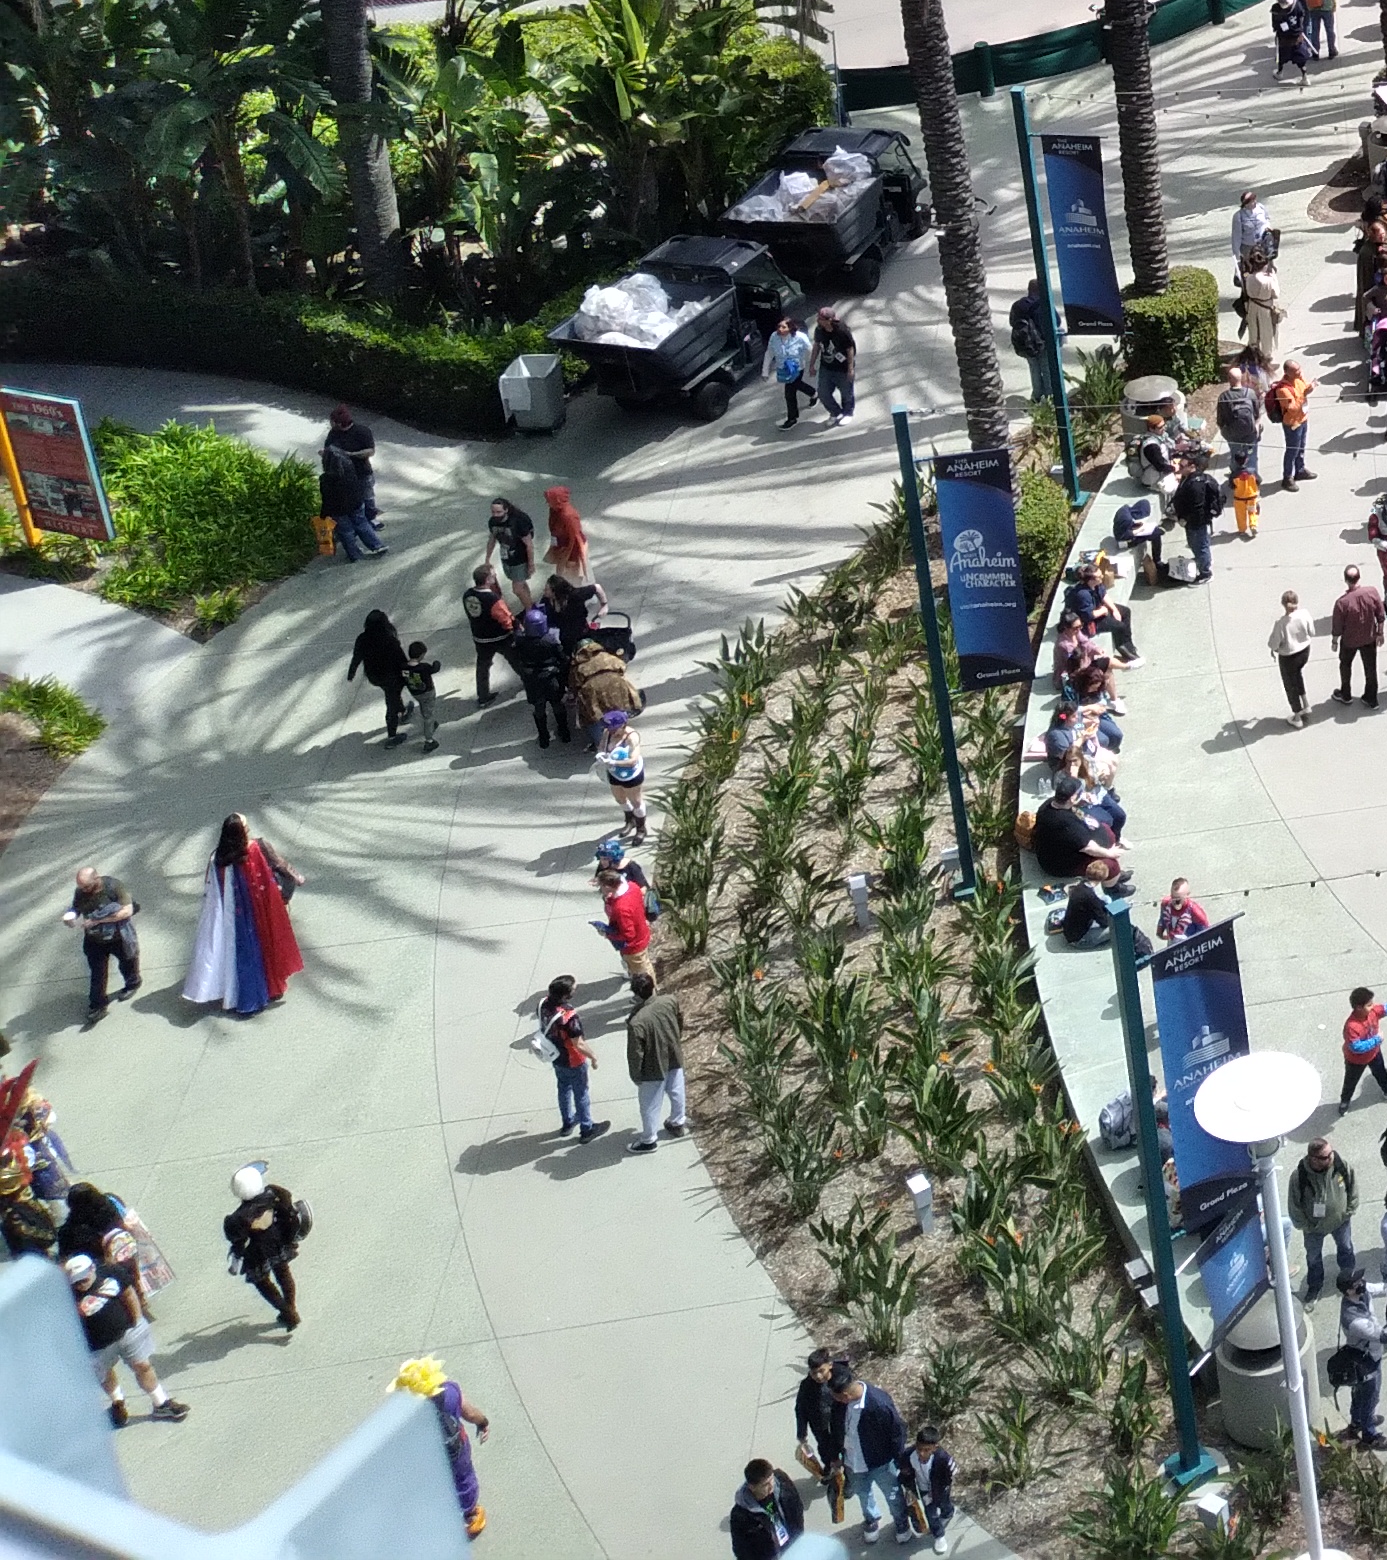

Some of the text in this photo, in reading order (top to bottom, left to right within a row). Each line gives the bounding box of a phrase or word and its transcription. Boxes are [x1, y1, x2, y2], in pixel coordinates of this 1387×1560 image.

[1051, 143, 1093, 151] ANAHEIM
[1059, 226, 1105, 236] ANAHEIM
[946, 459, 999, 473] ANAHEIM
[955, 470, 981, 478] RESORT
[950, 546, 1017, 573] Anaheim
[966, 579, 1016, 588] CHARACTER
[976, 668, 1021, 679] Grand Plaza
[1165, 936, 1224, 970] ANAHEIM
[1174, 955, 1204, 972] RESORT
[1200, 1182, 1248, 1211] Grand Plaza
